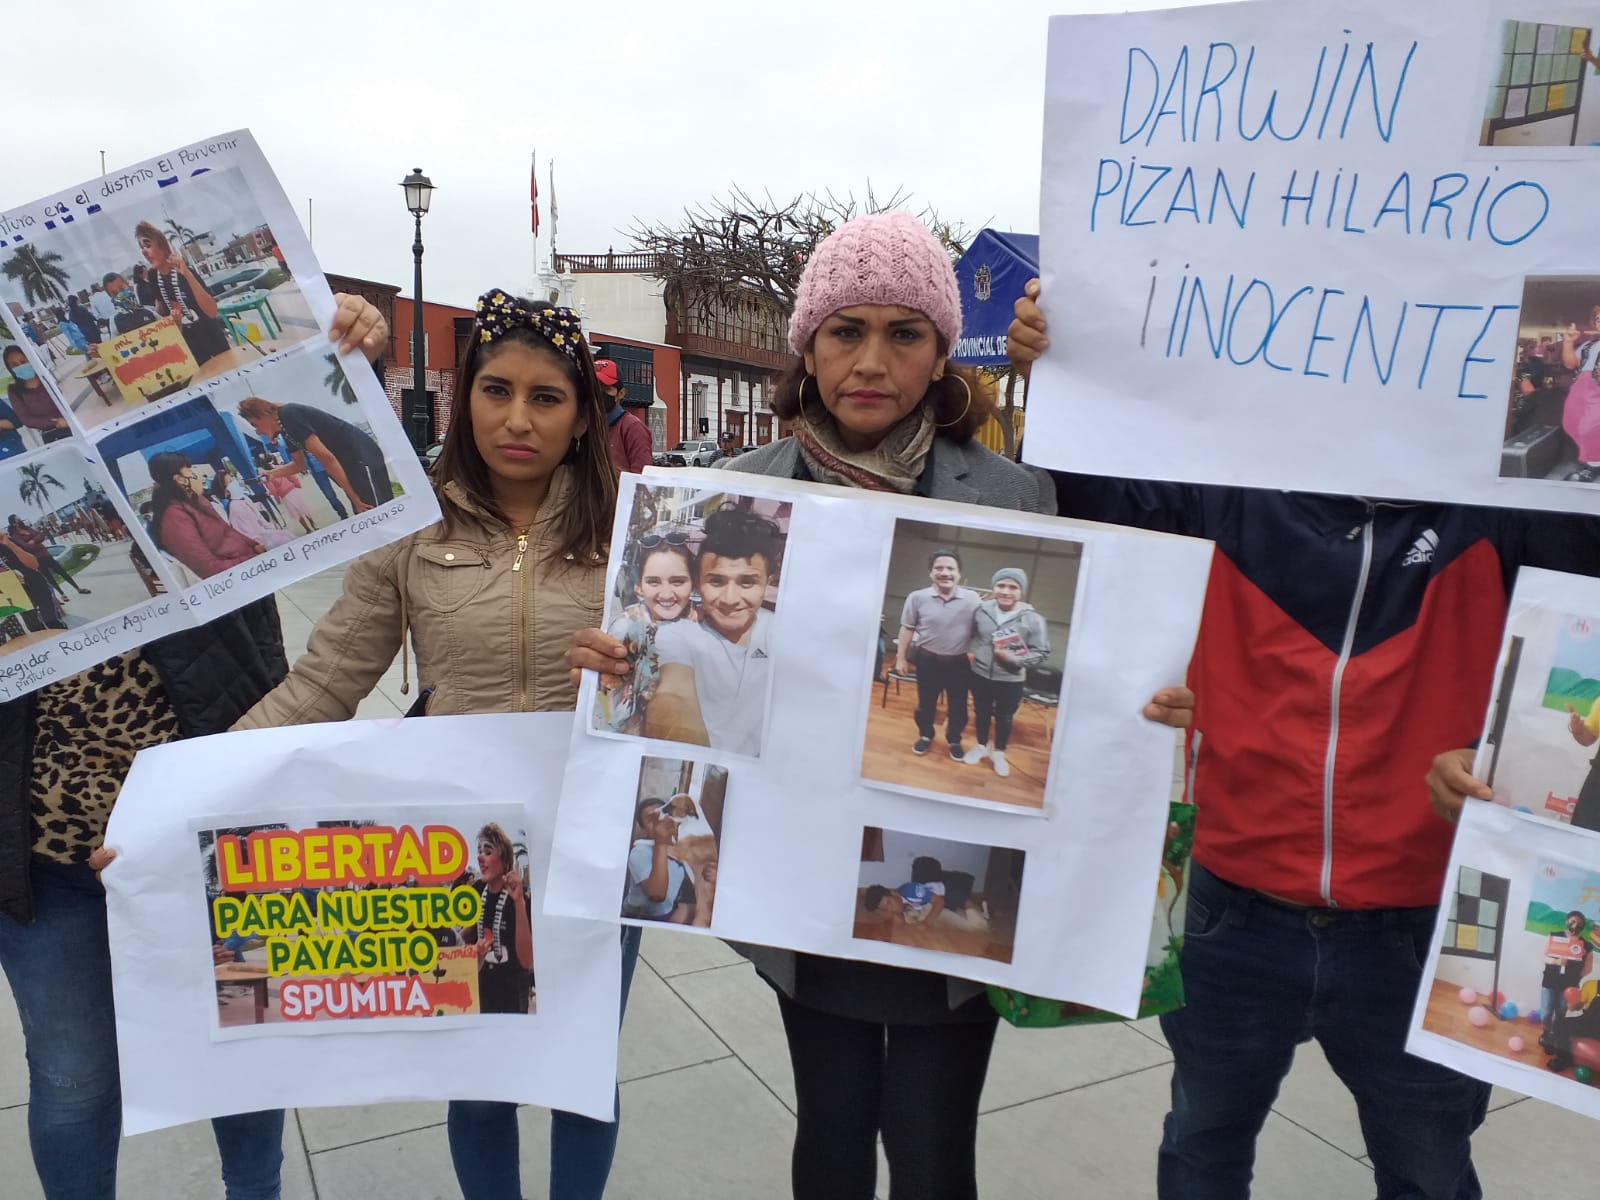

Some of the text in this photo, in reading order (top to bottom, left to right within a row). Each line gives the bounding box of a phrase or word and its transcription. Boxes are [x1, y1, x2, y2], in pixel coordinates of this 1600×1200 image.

[44, 201, 66, 218] en
[75, 189, 90, 205] el
[101, 168, 154, 198] distrito
[158, 158, 174, 174] El
[178, 138, 239, 166] Porvenir
[58, 627, 118, 657] Rodolfo
[122, 603, 171, 633] Aguilar
[203, 572, 234, 600] llevó
[282, 548, 296, 563] el
[302, 528, 348, 561] primer
[350, 502, 405, 535] concurso
[221, 829, 466, 888] LIBERTAD
[217, 889, 479, 935] PARA NUESTRO
[268, 934, 435, 973] PAYASITO
[281, 978, 432, 1018] SPUMITA
